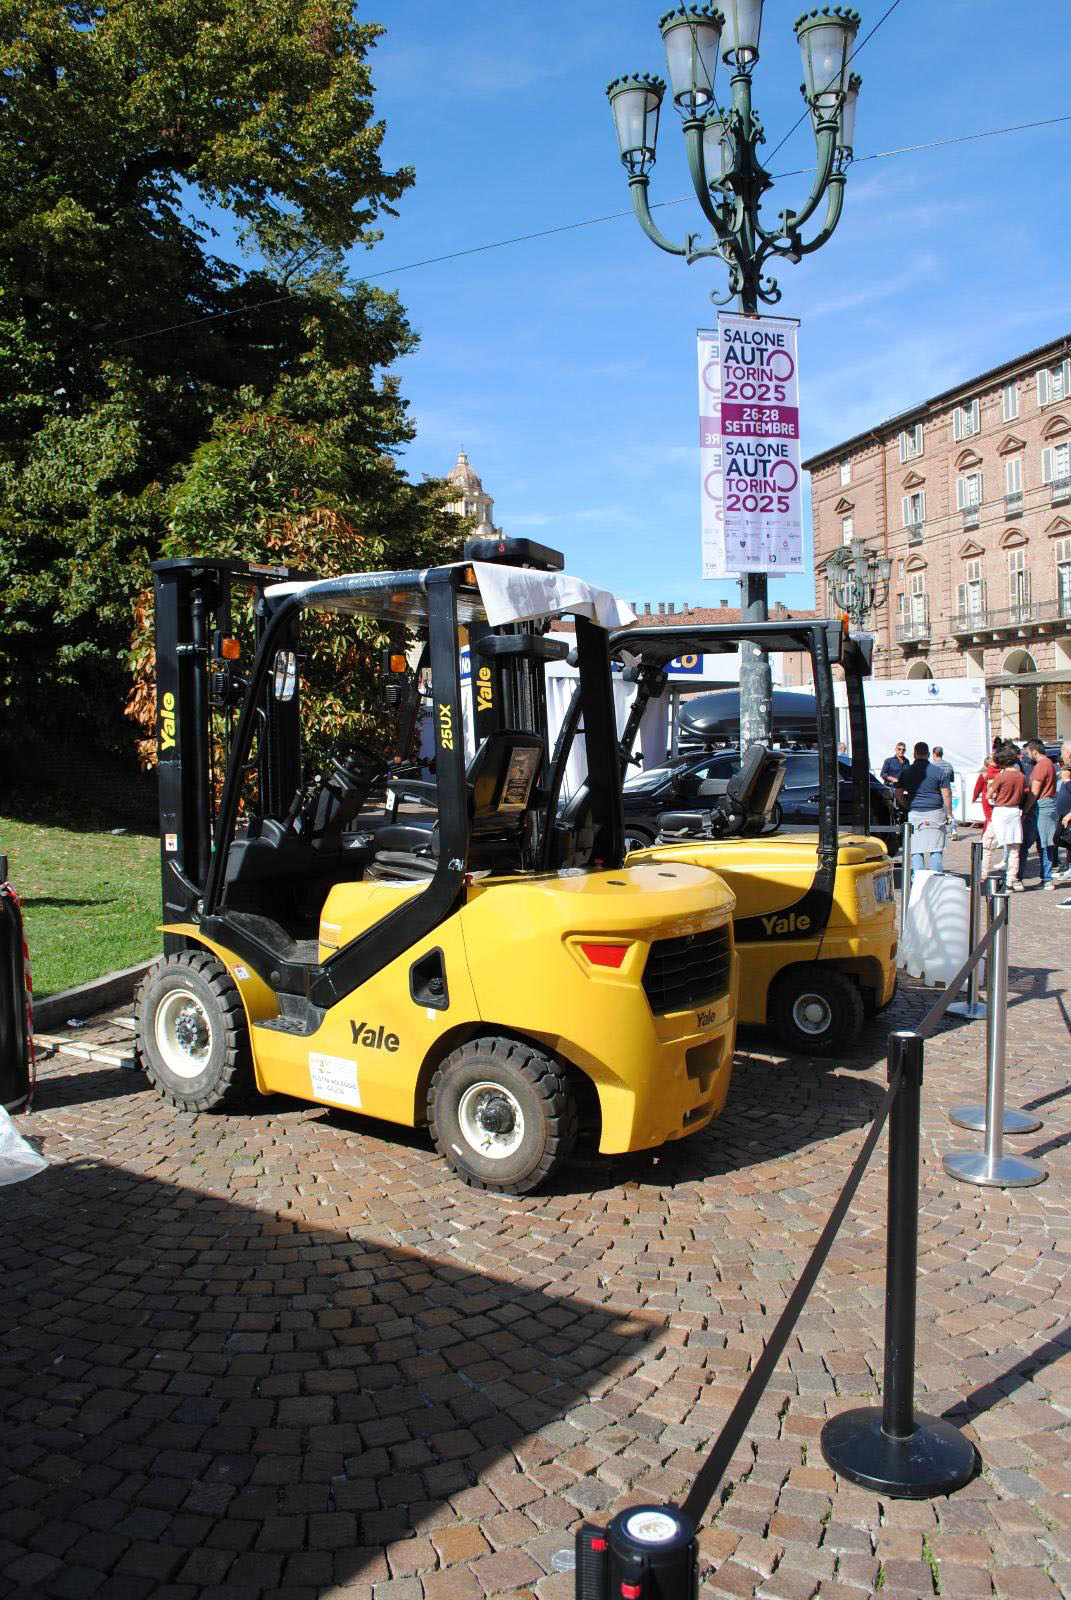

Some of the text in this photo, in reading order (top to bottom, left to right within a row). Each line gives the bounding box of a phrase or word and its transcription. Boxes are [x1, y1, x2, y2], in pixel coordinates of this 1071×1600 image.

[724, 329, 785, 347] SALONE
[724, 345, 795, 381] AUTO
[724, 381, 786, 402] 2025
[743, 408, 779, 421] 26-28
[725, 421, 795, 435] SETTEMBRE
[726, 442, 789, 457] SALONE
[726, 458, 798, 492] AUTO
[726, 494, 790, 513] 2025
[476, 667, 493, 712] Yale
[161, 692, 176, 751] Yale
[439, 703, 454, 750] 25UX
[761, 912, 811, 935] Yale
[697, 1010, 716, 1028] Yale
[350, 1019, 400, 1053] Yale
